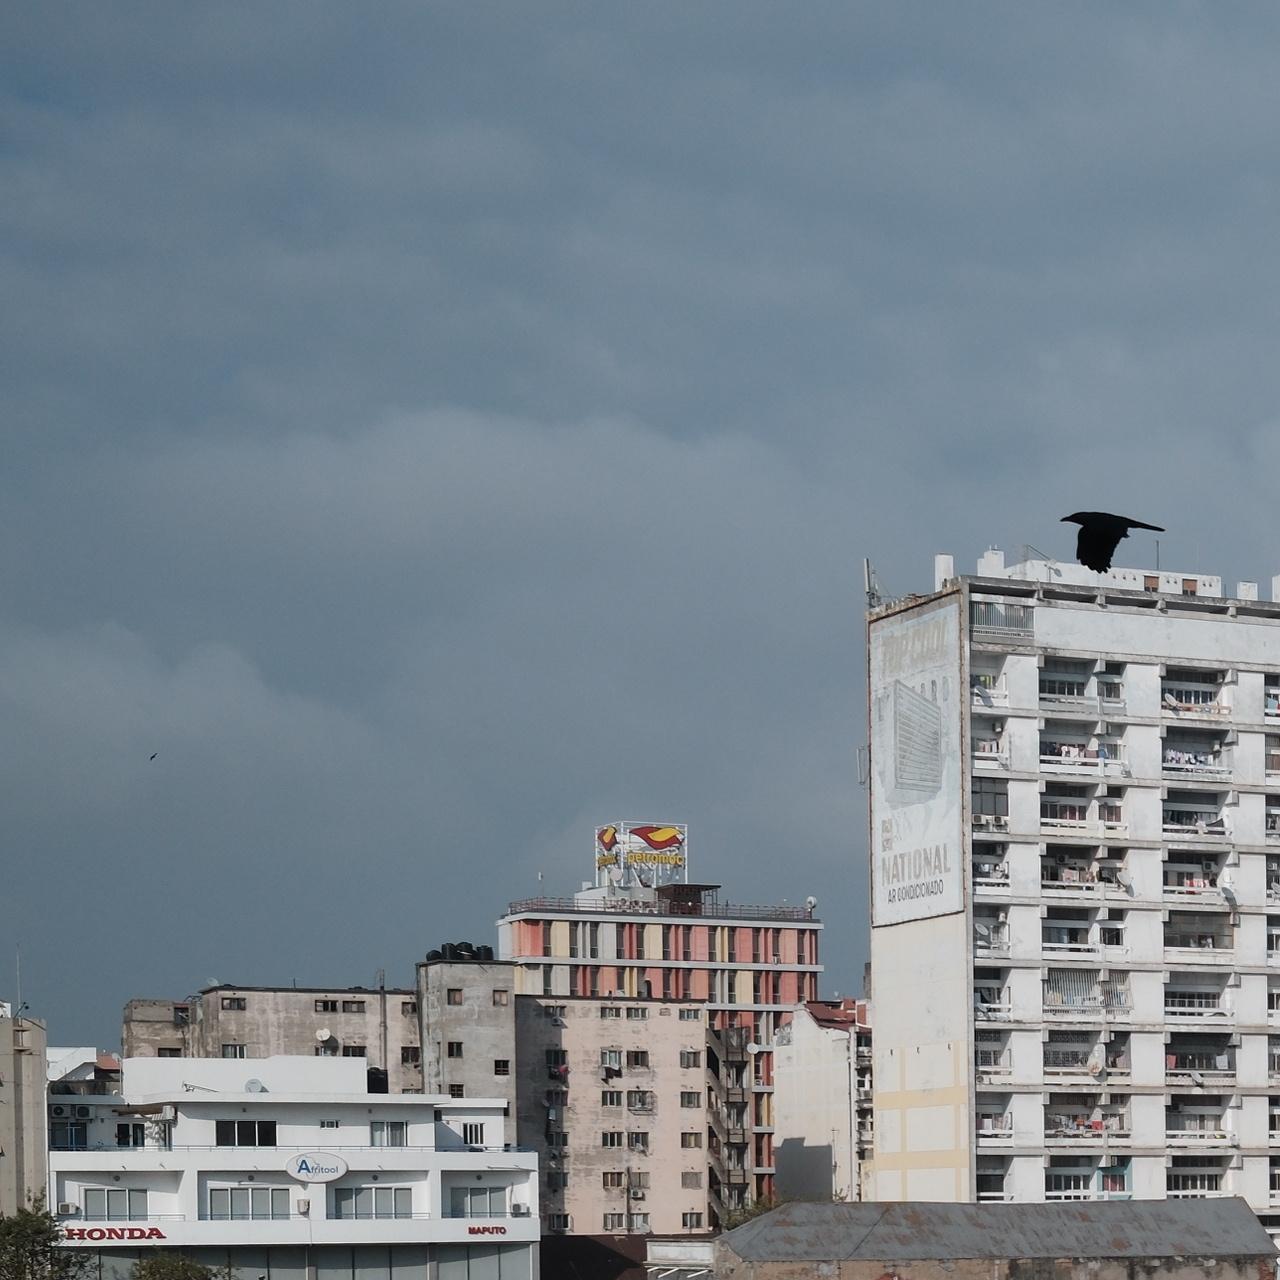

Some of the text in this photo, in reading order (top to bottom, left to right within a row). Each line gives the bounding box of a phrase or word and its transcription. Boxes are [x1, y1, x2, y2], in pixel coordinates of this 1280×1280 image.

[627, 852, 685, 864] petromoc
[881, 843, 951, 887] NATIONAL
[297, 1159, 339, 1174] Afritool
[65, 1227, 167, 1241] HONDA
[468, 1225, 507, 1235] MAPUTO
